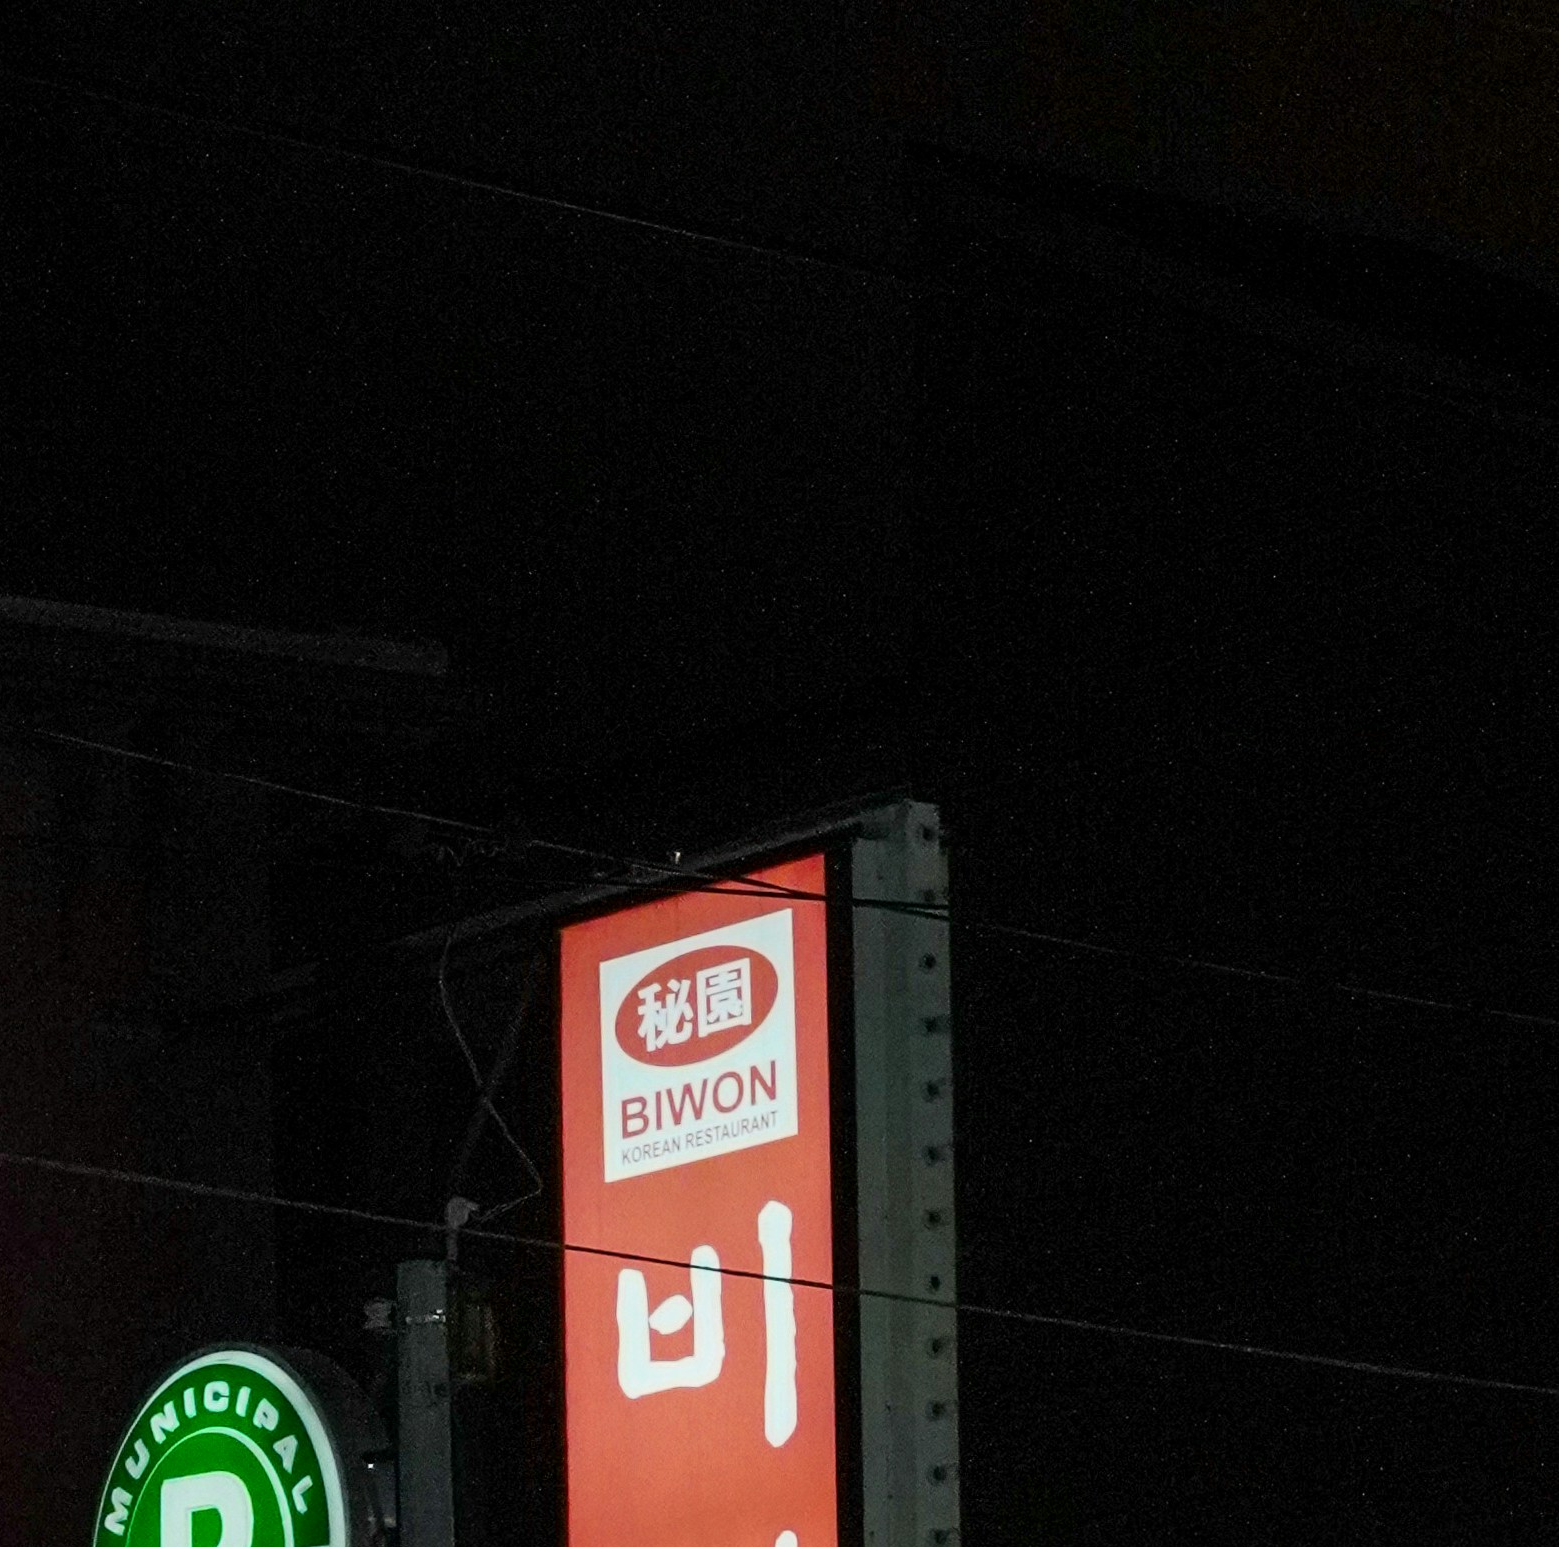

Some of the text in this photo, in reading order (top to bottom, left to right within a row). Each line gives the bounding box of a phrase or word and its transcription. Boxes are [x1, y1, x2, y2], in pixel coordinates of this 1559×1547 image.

[637, 957, 752, 1052] 秘園
[620, 1061, 777, 1139] BIWON
[621, 1110, 778, 1165] KOREAN RESTAURANT
[104, 1380, 313, 1536] MUNICIPAL
